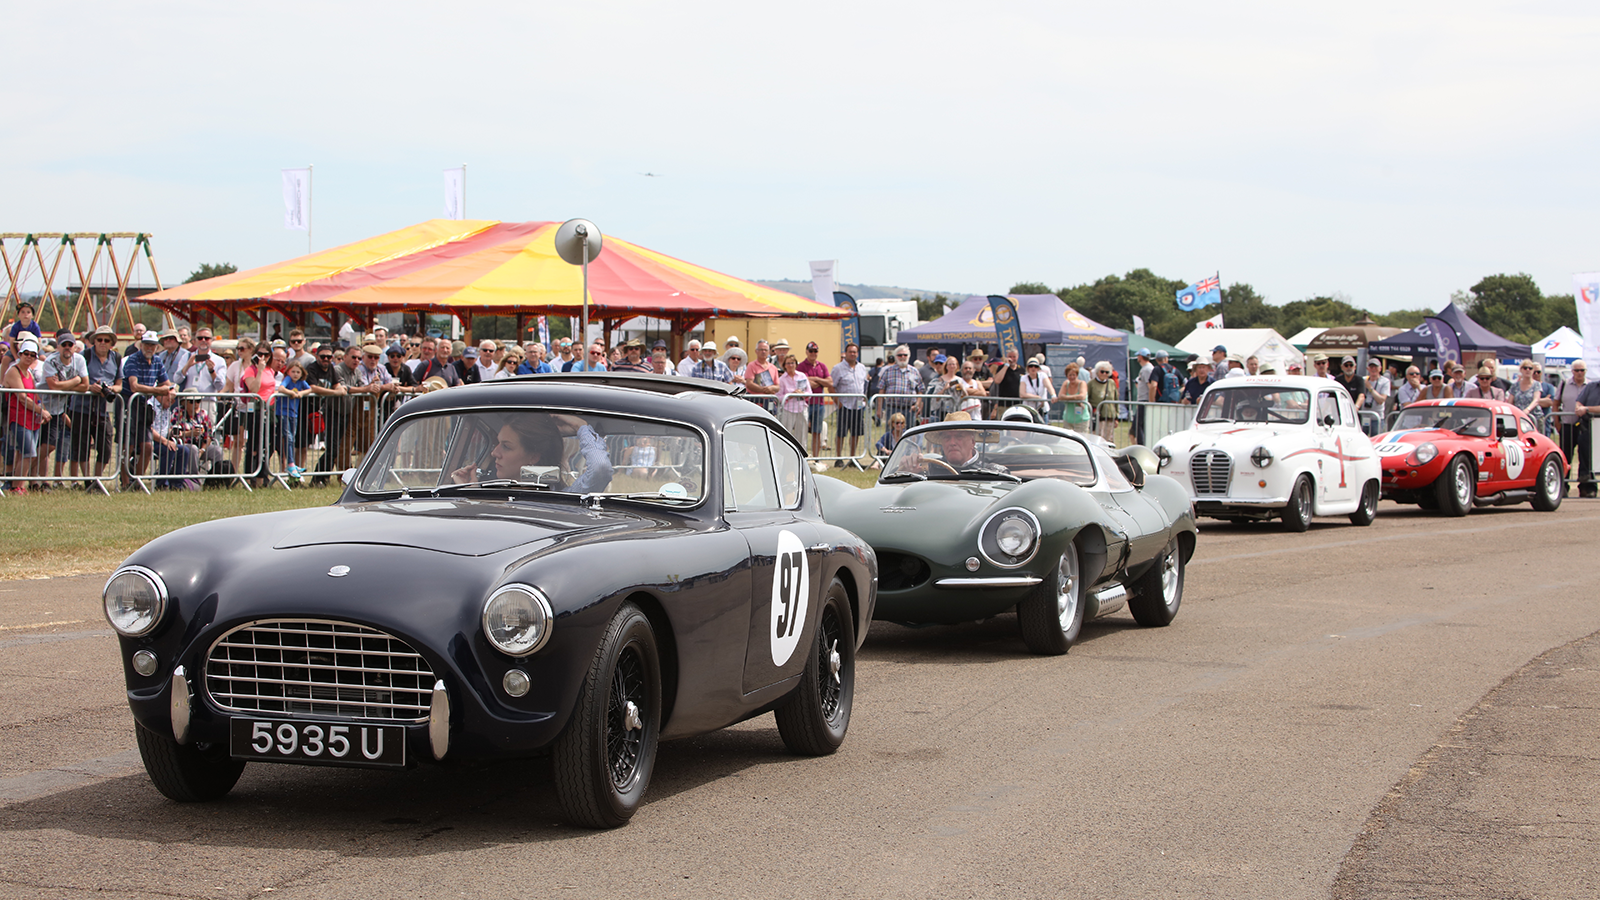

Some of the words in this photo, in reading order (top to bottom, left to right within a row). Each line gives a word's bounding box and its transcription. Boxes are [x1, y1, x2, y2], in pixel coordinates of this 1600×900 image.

[916, 332, 943, 341] HAWKER
[943, 332, 973, 340] TYPHOON
[1546, 358, 1567, 366] JAMES
[1334, 435, 1348, 489] 1
[1504, 444, 1520, 467] 101
[776, 551, 803, 639] 97
[251, 721, 351, 758] 5935
[361, 727, 384, 760] U
